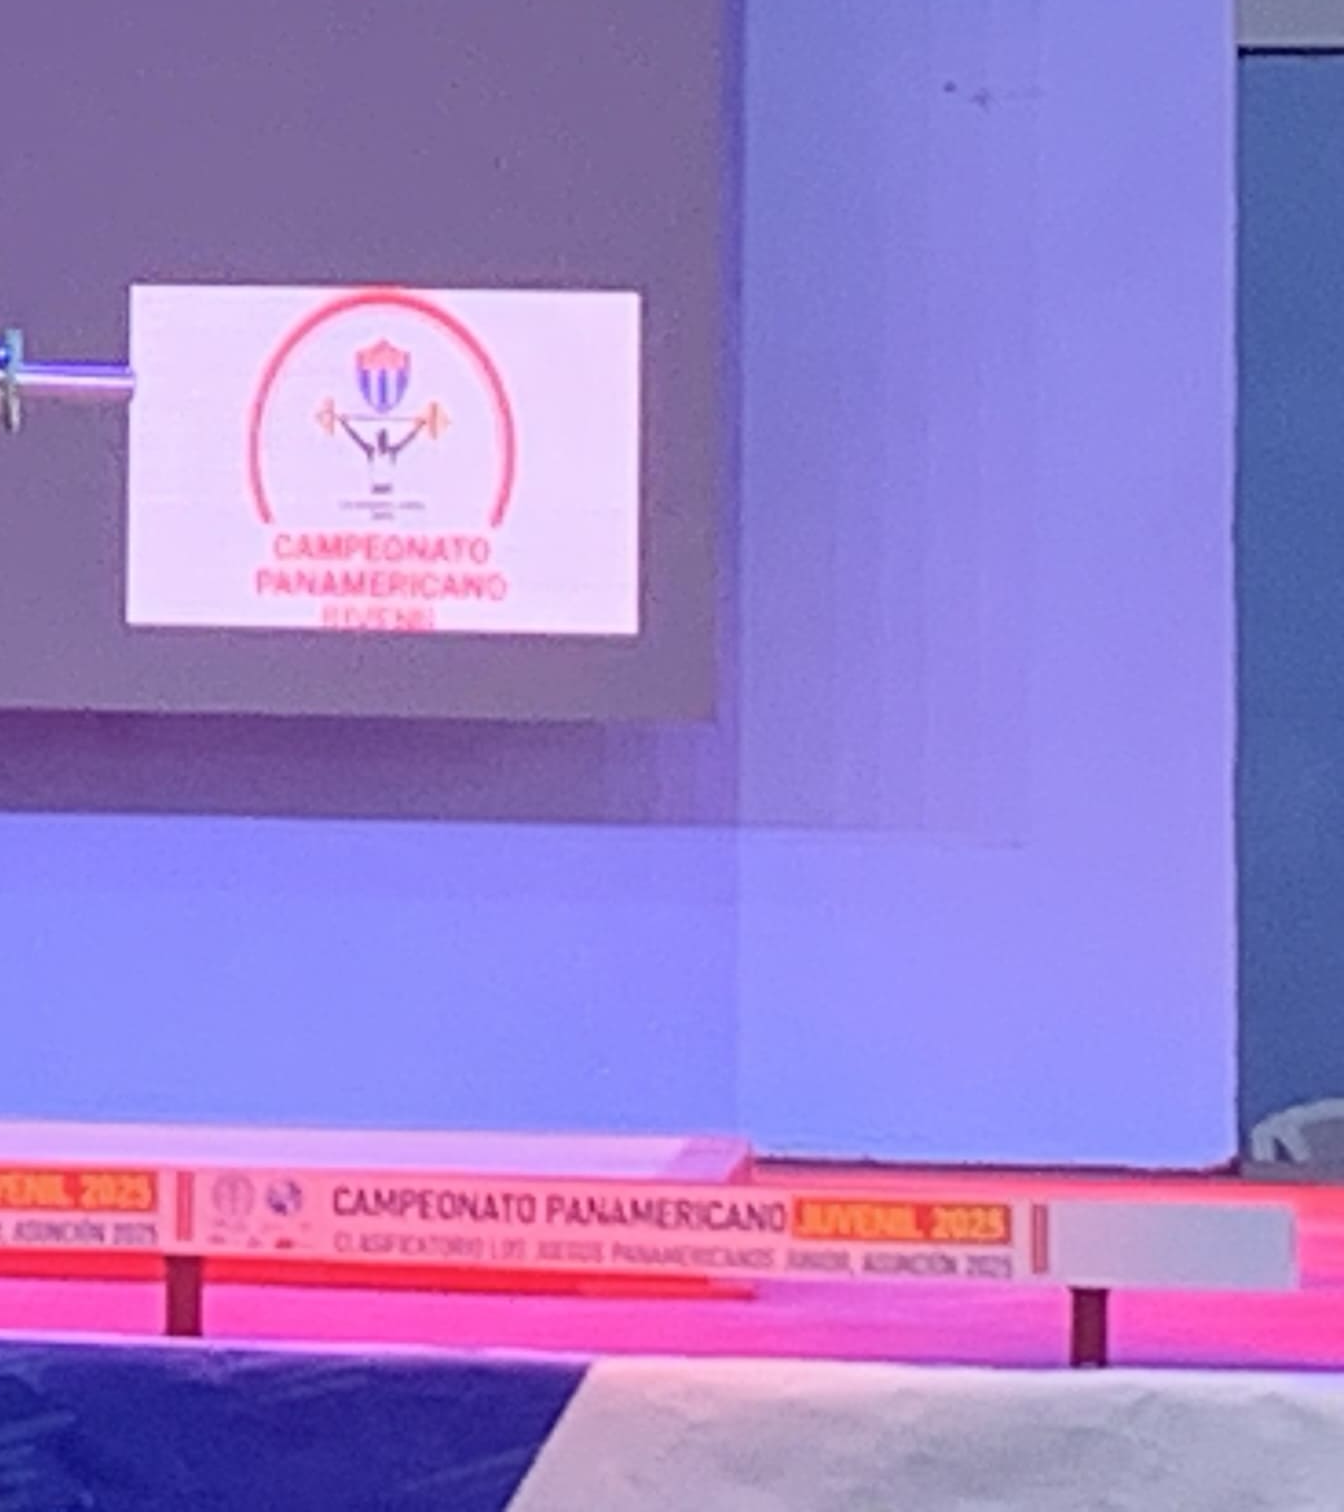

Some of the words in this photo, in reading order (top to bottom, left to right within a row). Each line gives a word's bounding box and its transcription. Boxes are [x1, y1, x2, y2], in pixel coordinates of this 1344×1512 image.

[274, 534, 491, 564] CAMPEONATO
[256, 570, 508, 602] PANAMERICANO
[332, 1186, 537, 1225] CAMPEONATO
[546, 1194, 787, 1234] PANAMERICANO
